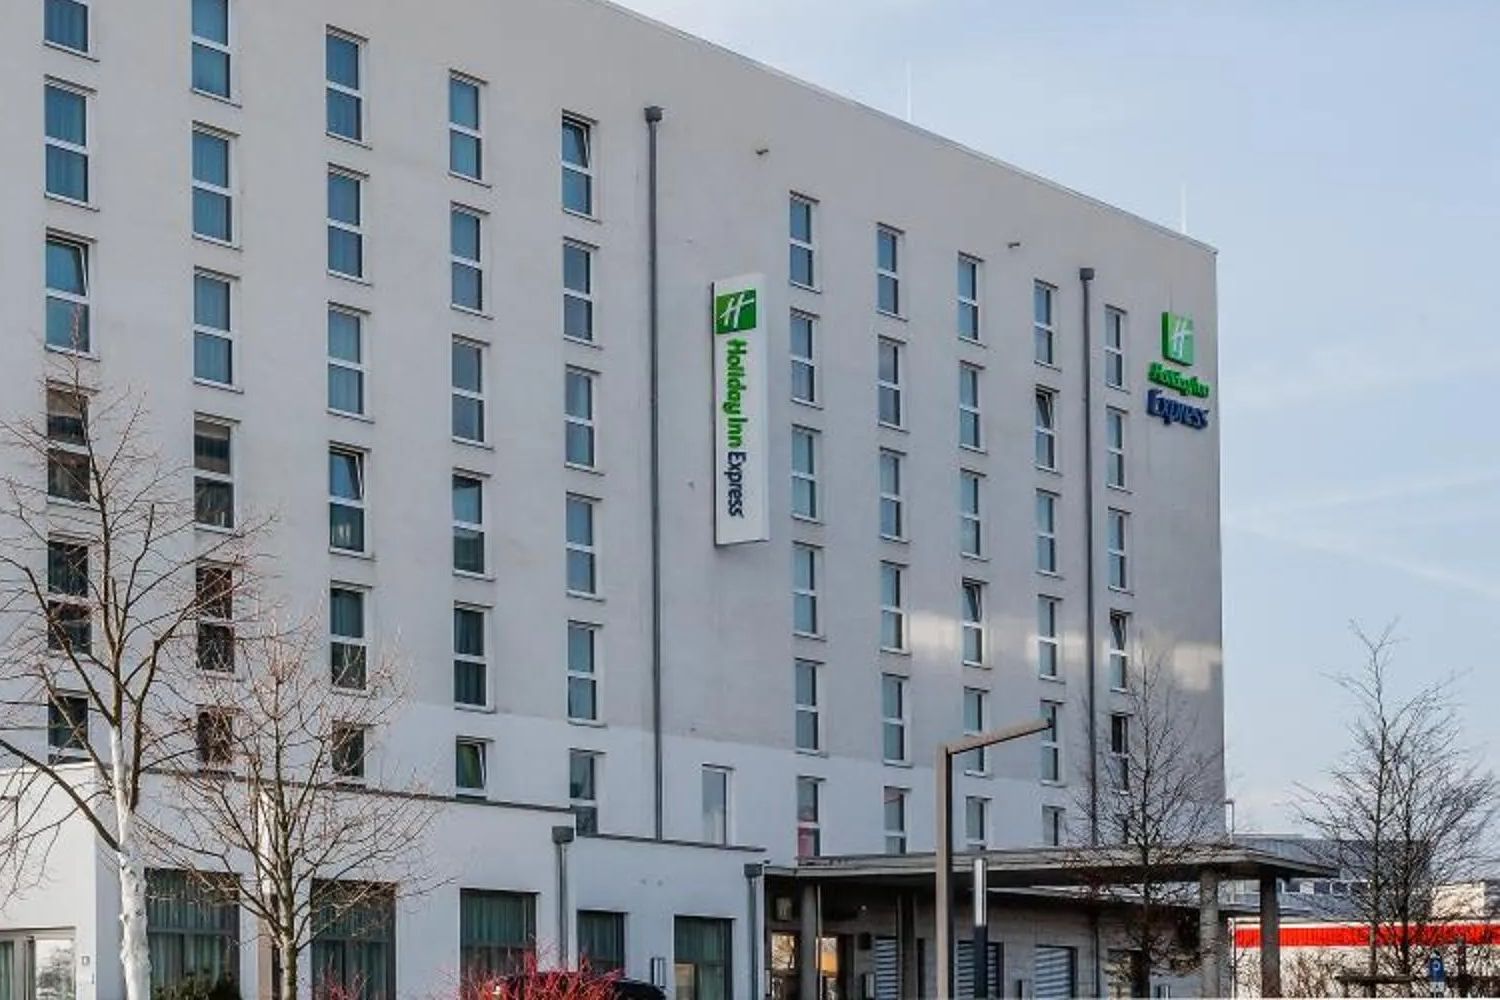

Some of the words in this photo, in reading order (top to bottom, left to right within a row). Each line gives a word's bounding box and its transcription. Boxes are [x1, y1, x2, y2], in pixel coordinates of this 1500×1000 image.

[723, 338, 748, 414] Holiday
[727, 417, 748, 449] Inn
[724, 451, 747, 518] Express
